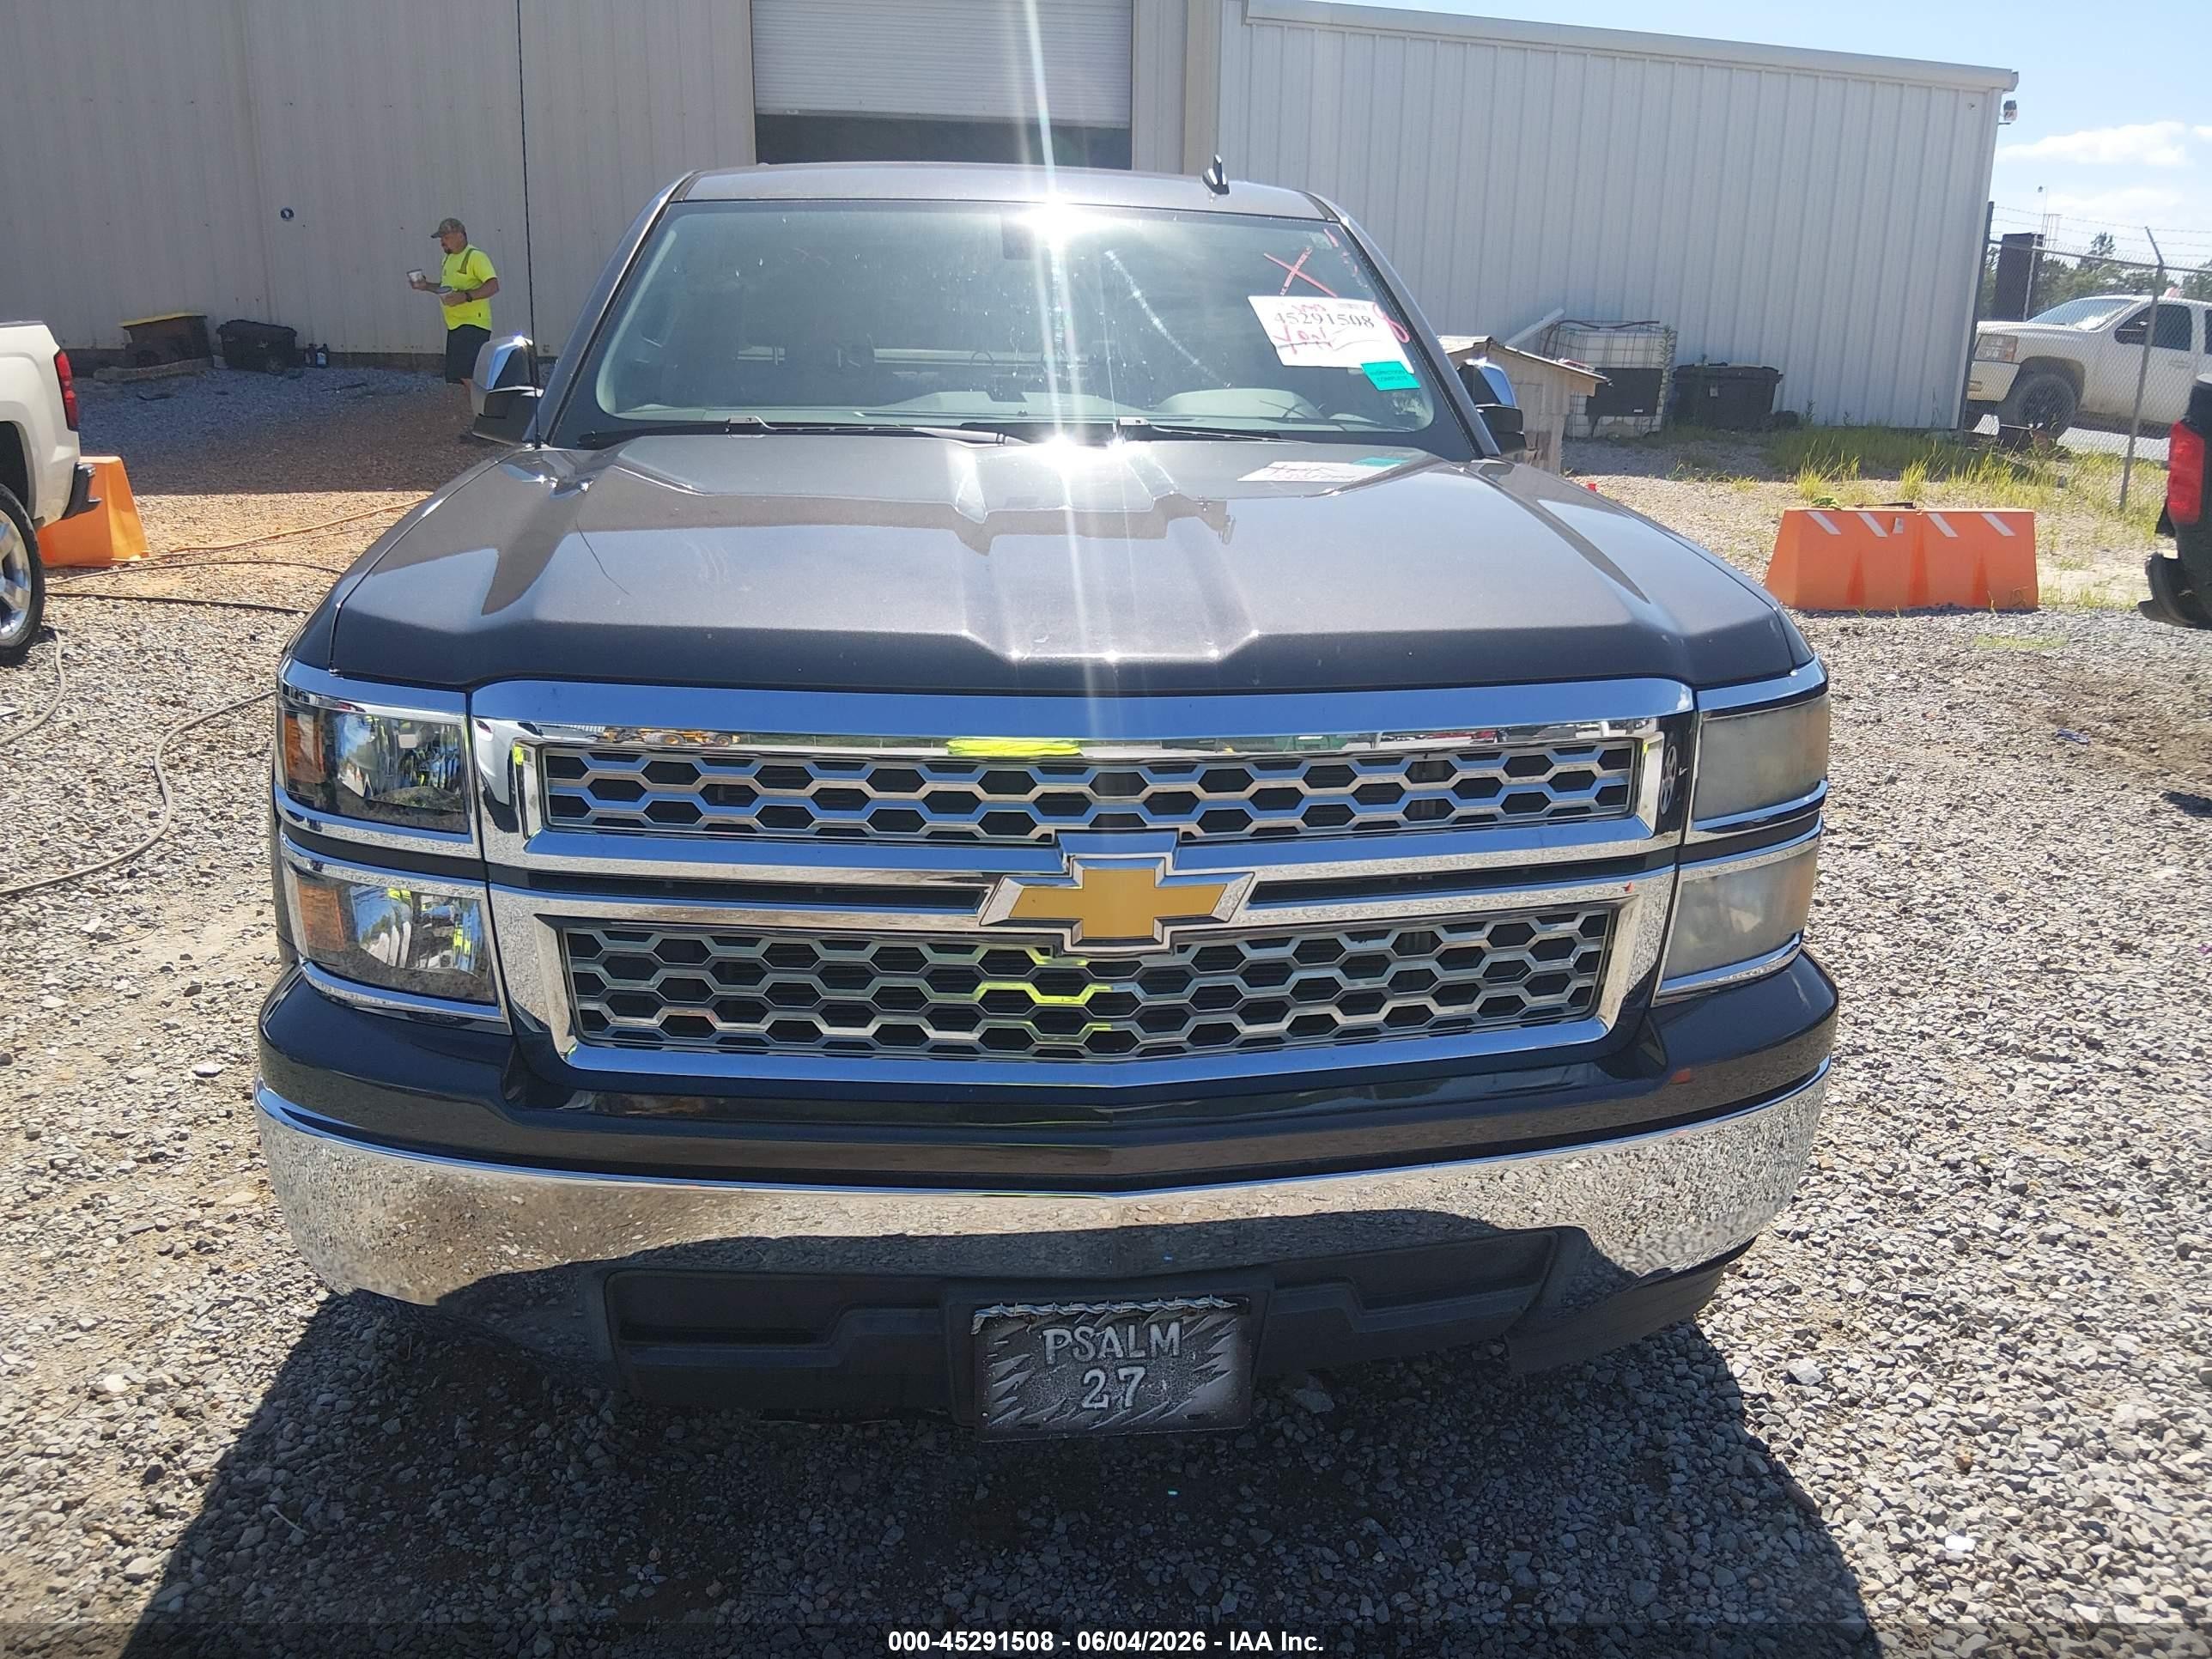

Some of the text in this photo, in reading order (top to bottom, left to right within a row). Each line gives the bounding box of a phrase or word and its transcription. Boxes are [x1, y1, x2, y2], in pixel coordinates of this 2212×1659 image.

[1273, 312, 1376, 330] 45291508
[1042, 1322, 1183, 1365] PSALM
[1081, 1365, 1146, 1410] 27
